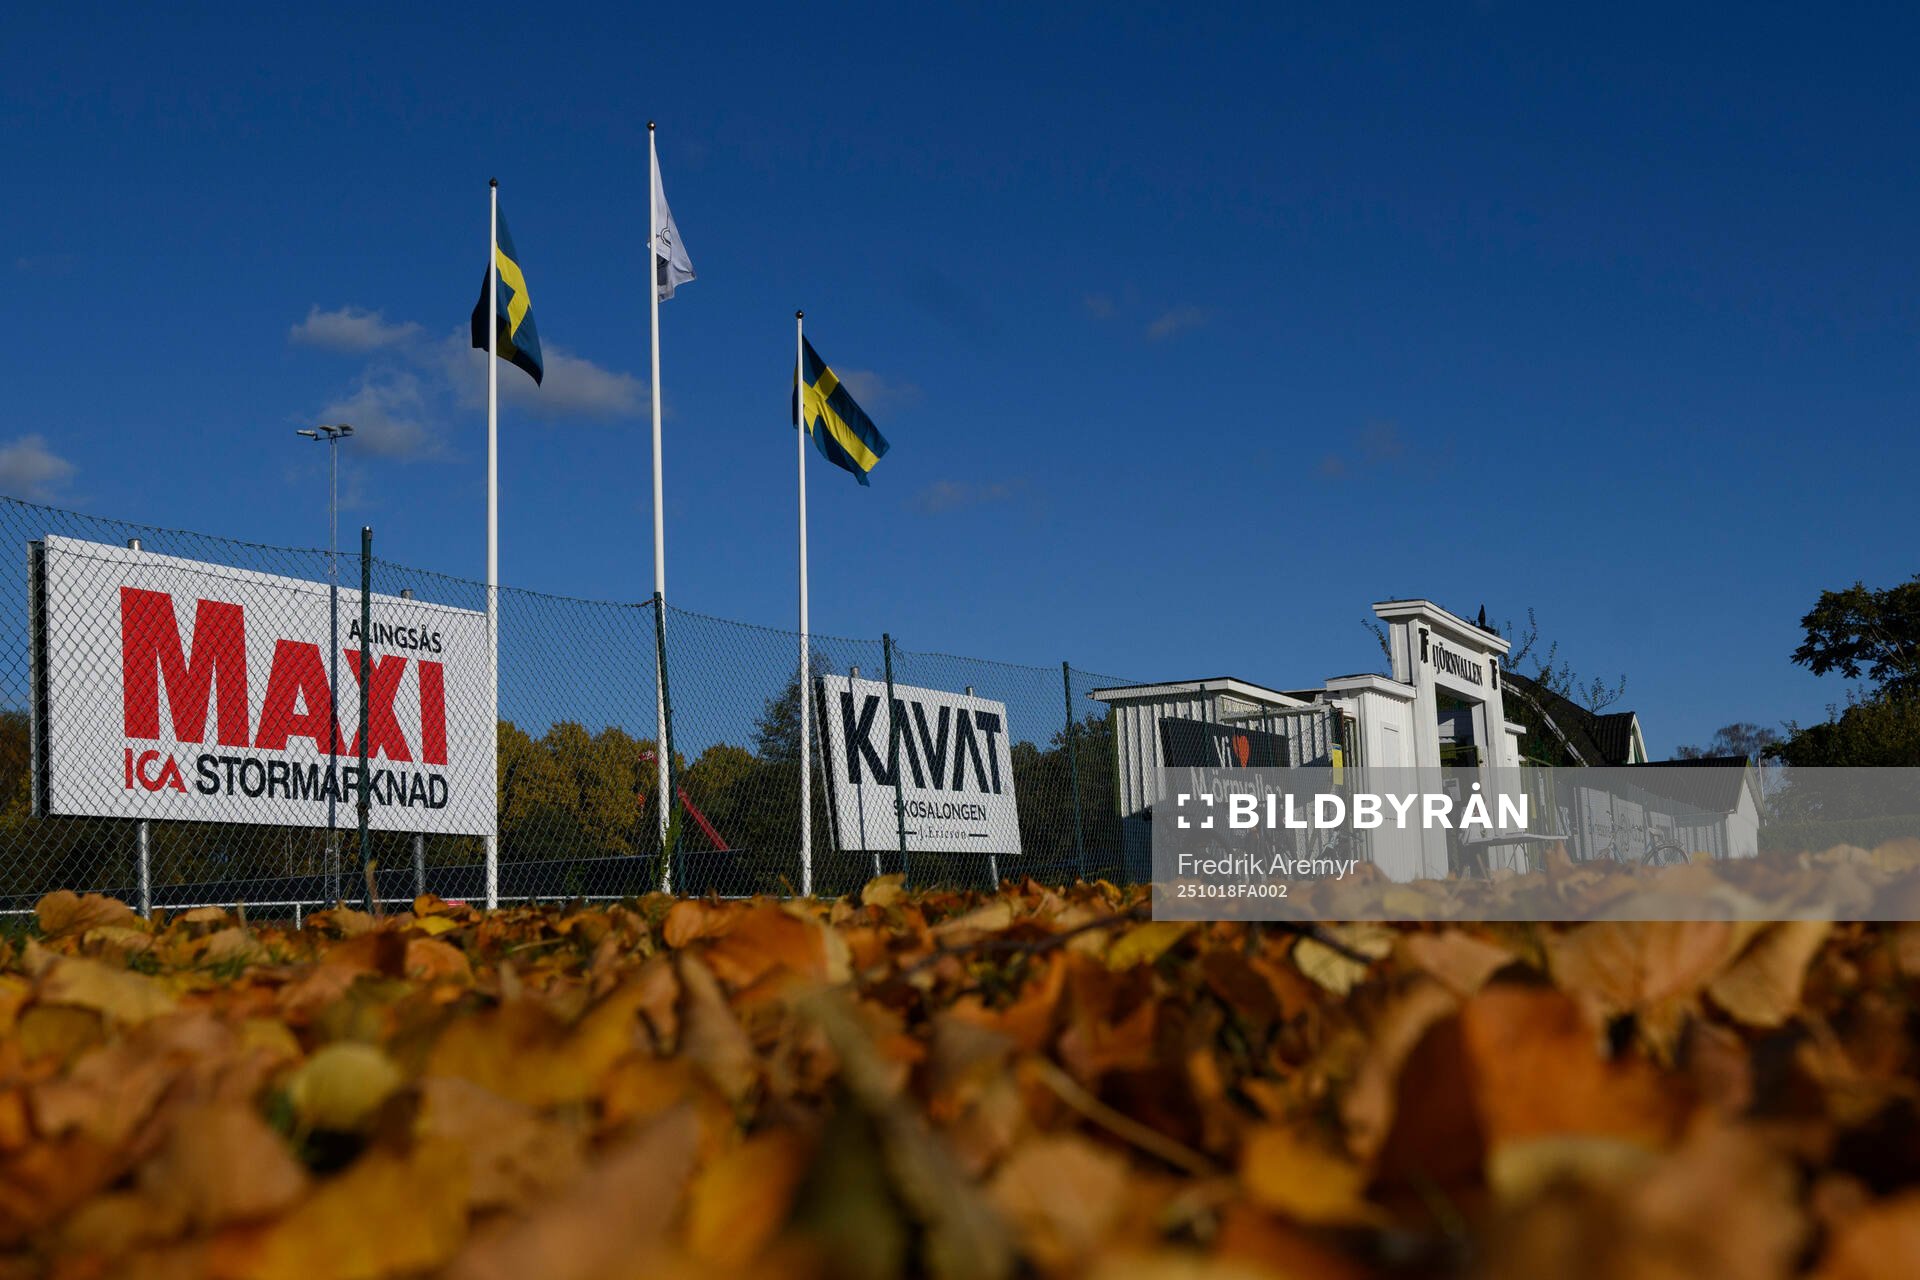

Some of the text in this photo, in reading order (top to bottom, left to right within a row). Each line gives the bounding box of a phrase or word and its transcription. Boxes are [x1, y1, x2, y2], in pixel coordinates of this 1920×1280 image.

[120, 586, 448, 765] MAXI
[349, 619, 442, 654] AINGSÅS
[124, 747, 449, 810] ICA STORMARKNAD
[839, 691, 1002, 795] KAVAT
